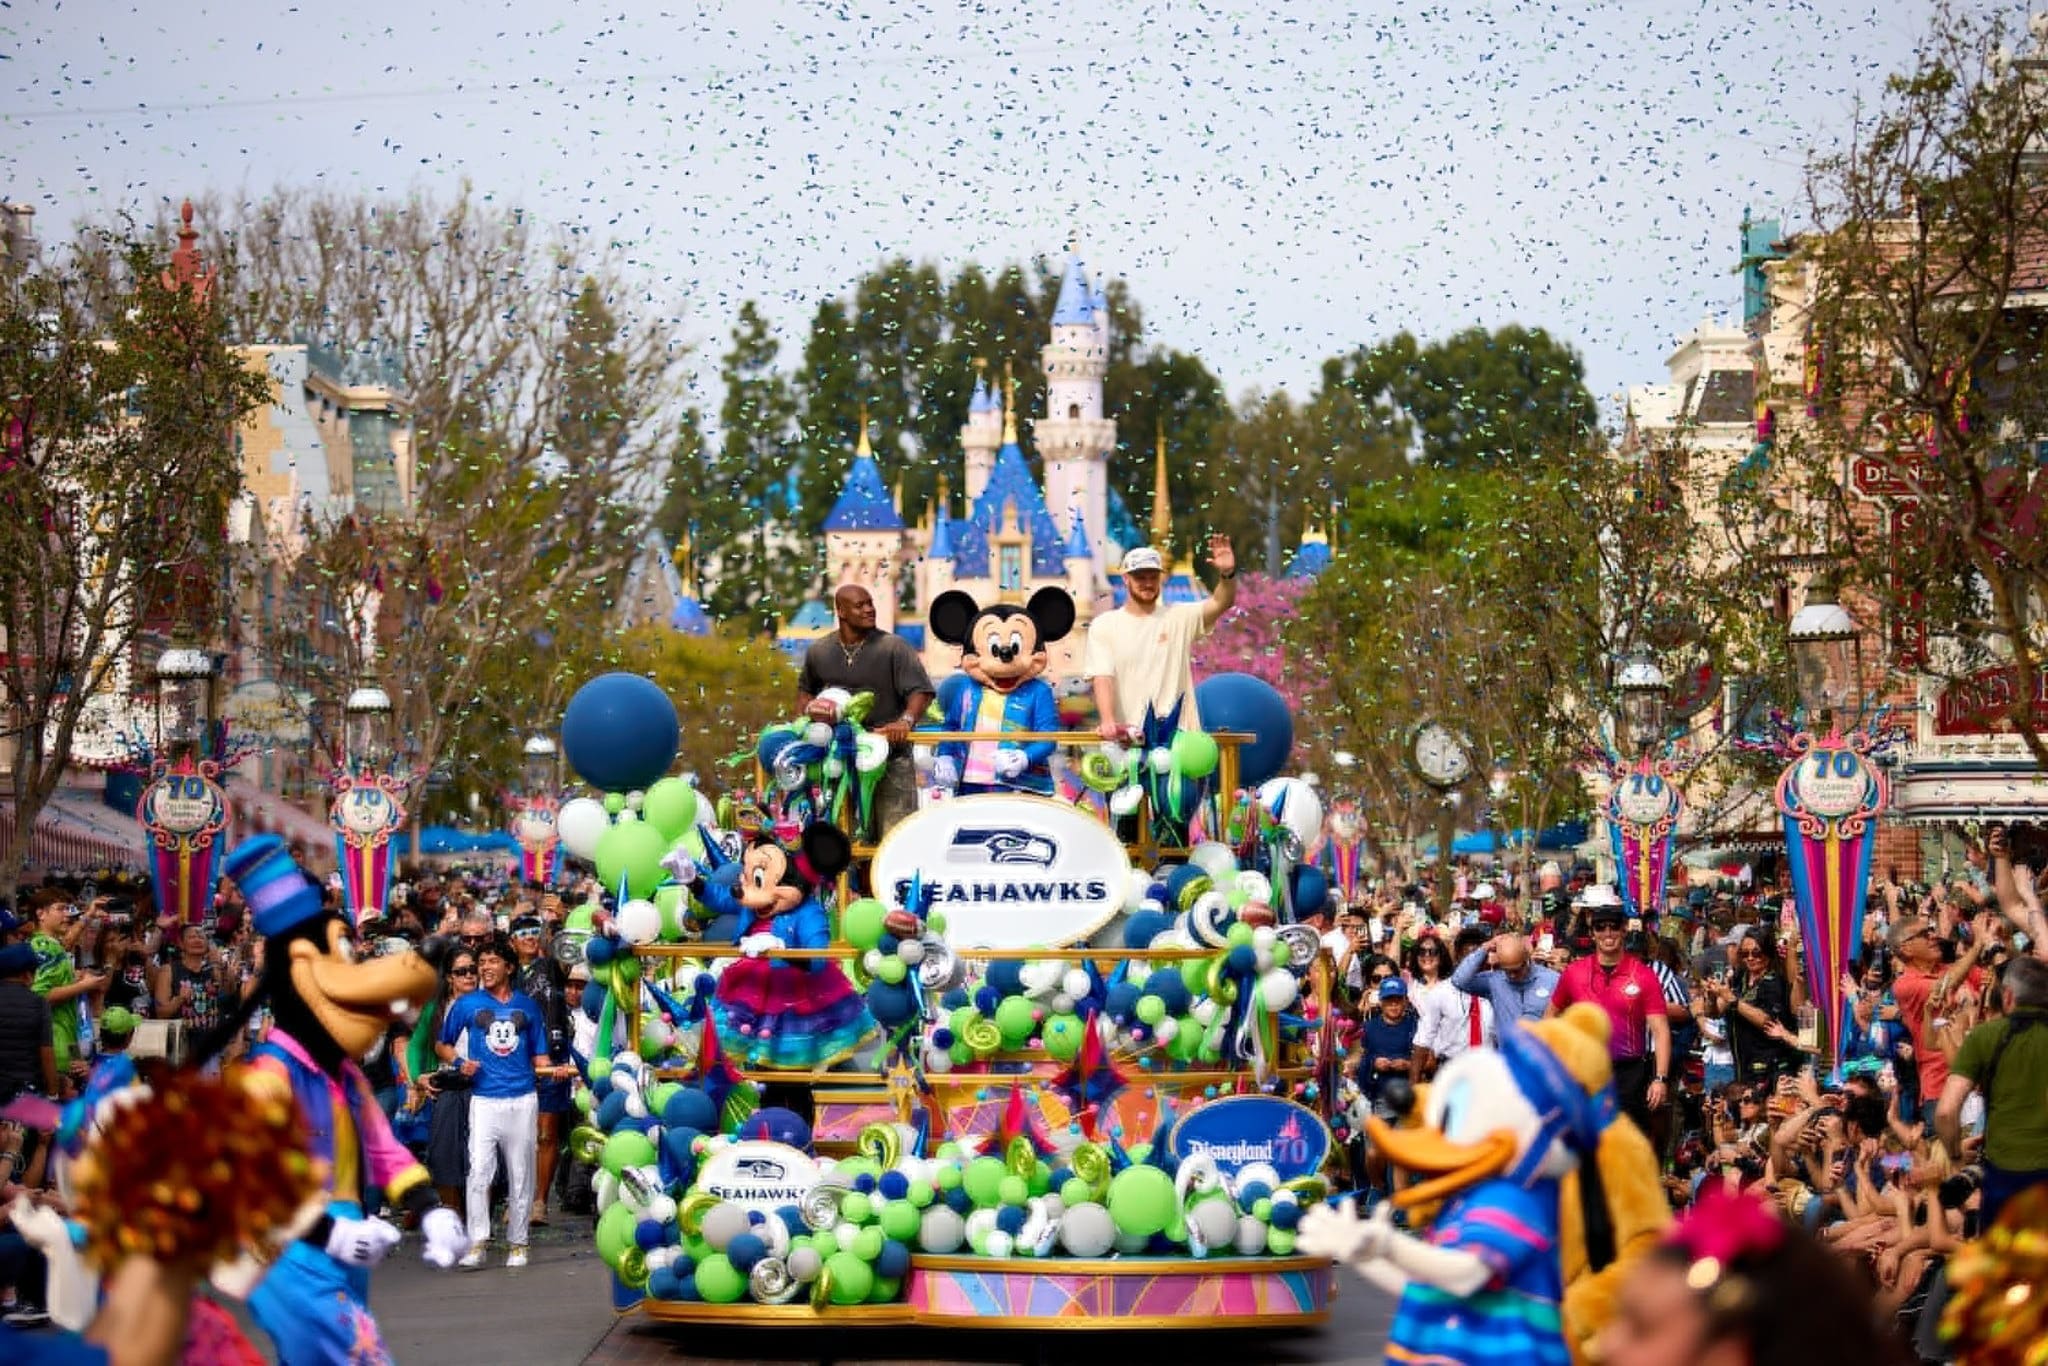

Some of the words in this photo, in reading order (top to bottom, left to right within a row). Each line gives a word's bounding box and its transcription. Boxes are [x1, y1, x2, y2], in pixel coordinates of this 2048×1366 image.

[1812, 750, 1858, 779] 70
[167, 775, 205, 799] 70
[353, 787, 382, 806] 70
[1631, 773, 1663, 796] 70
[894, 879, 1106, 904] SEAHAWKS
[1187, 1139, 1273, 1165] Disneyland
[1275, 1138, 1309, 1164] 70
